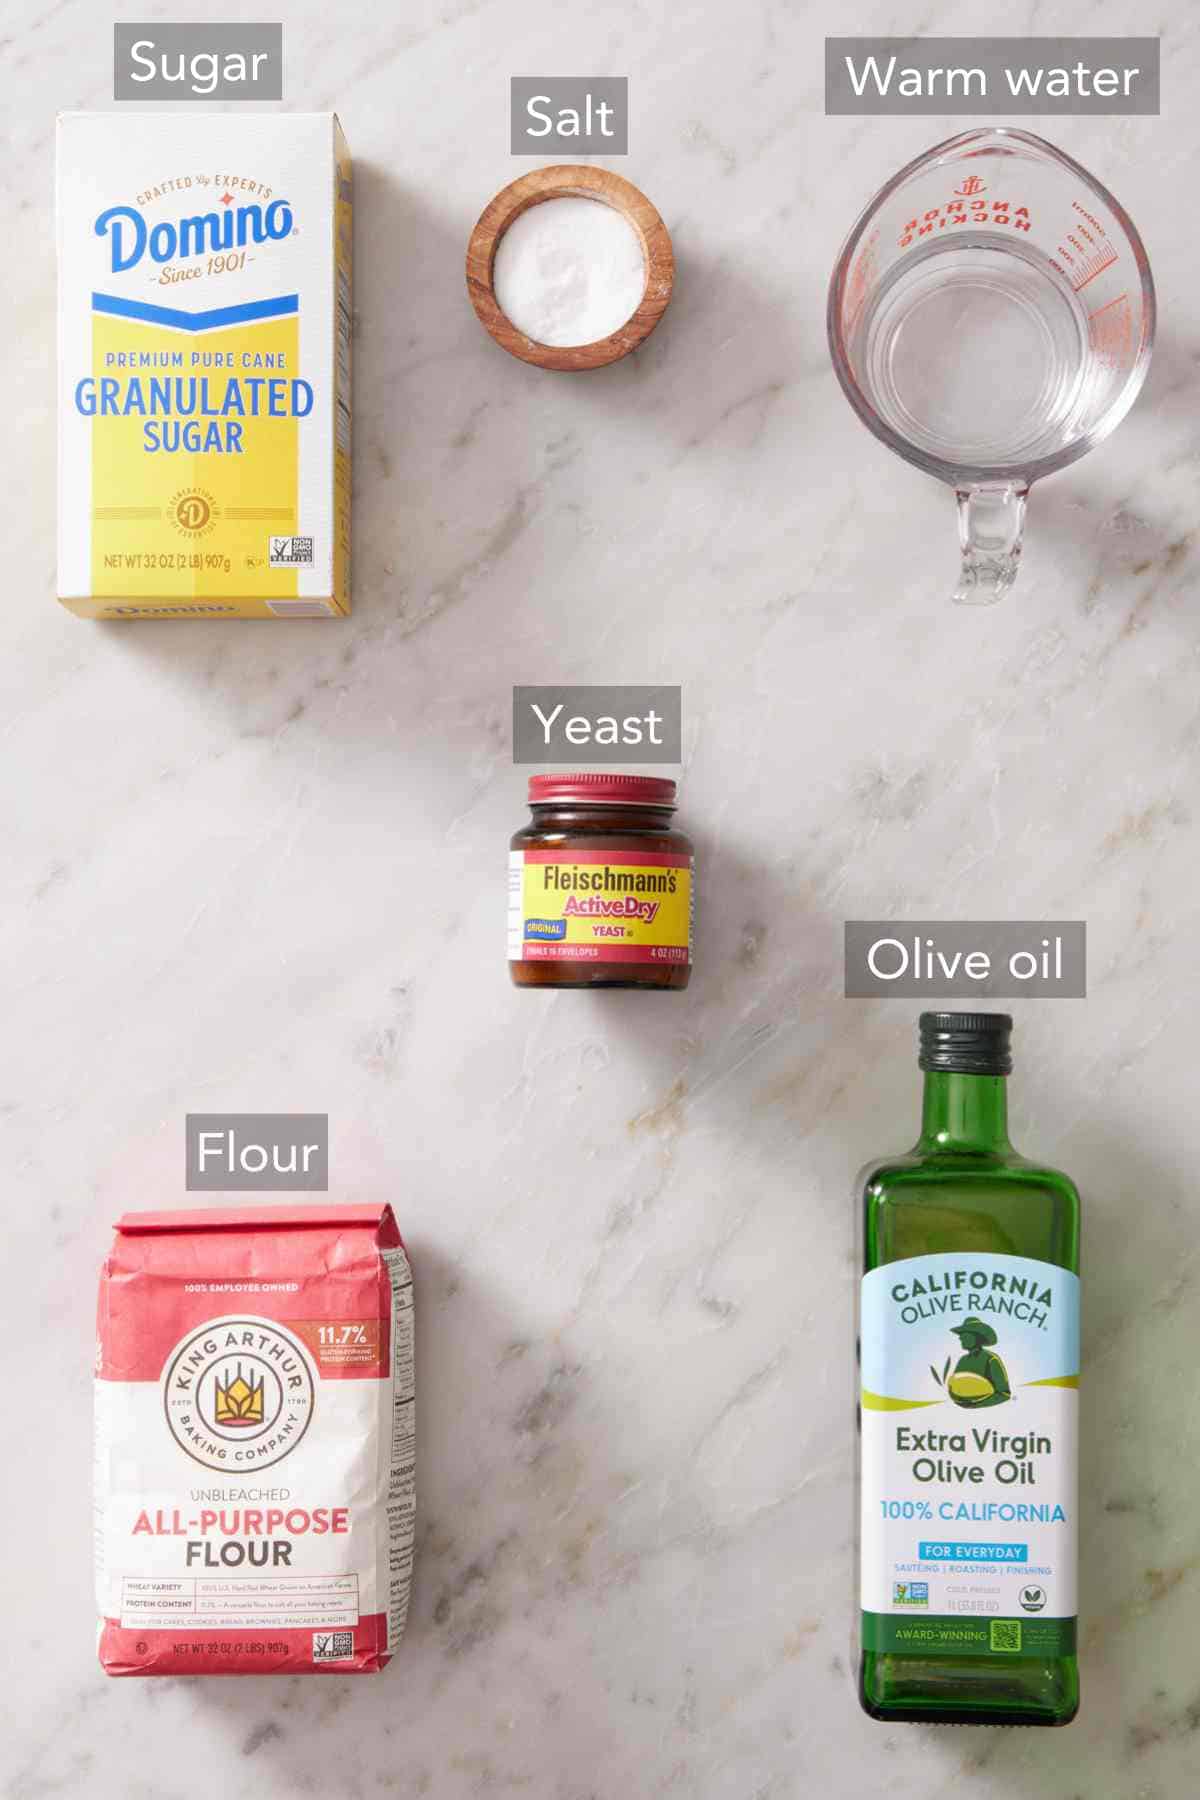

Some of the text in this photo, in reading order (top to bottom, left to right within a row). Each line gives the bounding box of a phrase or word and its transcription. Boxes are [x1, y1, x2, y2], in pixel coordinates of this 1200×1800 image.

[136, 177, 192, 205] CRAFTED
[216, 175, 272, 199] EXPERTS
[94, 200, 292, 273] Domino
[106, 352, 286, 369] PREMIUM PURE CANE
[75, 377, 314, 418] GRANULATED
[143, 421, 243, 453] SUGAR
[104, 554, 122, 568] NET
[126, 554, 142, 569] WT
[144, 554, 156, 569] 32
[159, 554, 175, 569] OZ
[177, 553, 186, 571] (2
[189, 553, 203, 571] LB)
[206, 554, 231, 573] 907g
[544, 865, 676, 894] Fleischmann's
[593, 926, 625, 937] YEAST
[184, 1283, 298, 1293] 100% EMPLOYEE OWNED
[891, 1271, 1052, 1307] CALIFORNIA
[901, 1293, 1048, 1328] OLIVE RANCH
[318, 1325, 367, 1344] 11.7%
[176, 1332, 302, 1390] KING ARTHUR
[180, 1414, 299, 1461] BAKING COMPANY
[896, 1427, 1051, 1459] Extra Virgin
[912, 1458, 1035, 1485] Olive Oil
[190, 1488, 290, 1501] UNBLEACHED
[132, 1508, 349, 1535] ALL-PURPOSE
[881, 1501, 1066, 1522] 100% CALIFORNIA
[186, 1541, 292, 1567] FLOUR
[925, 1546, 1021, 1559] FOR EVERYDAY
[950, 1565, 997, 1574] ROASTING
[152, 1583, 181, 1591] VARIETY
[126, 1600, 192, 1608] PROTEIN CONTENT
[896, 1630, 988, 1641] AWARD-WINNING
[174, 1644, 189, 1654] NET
[192, 1644, 204, 1654] WT
